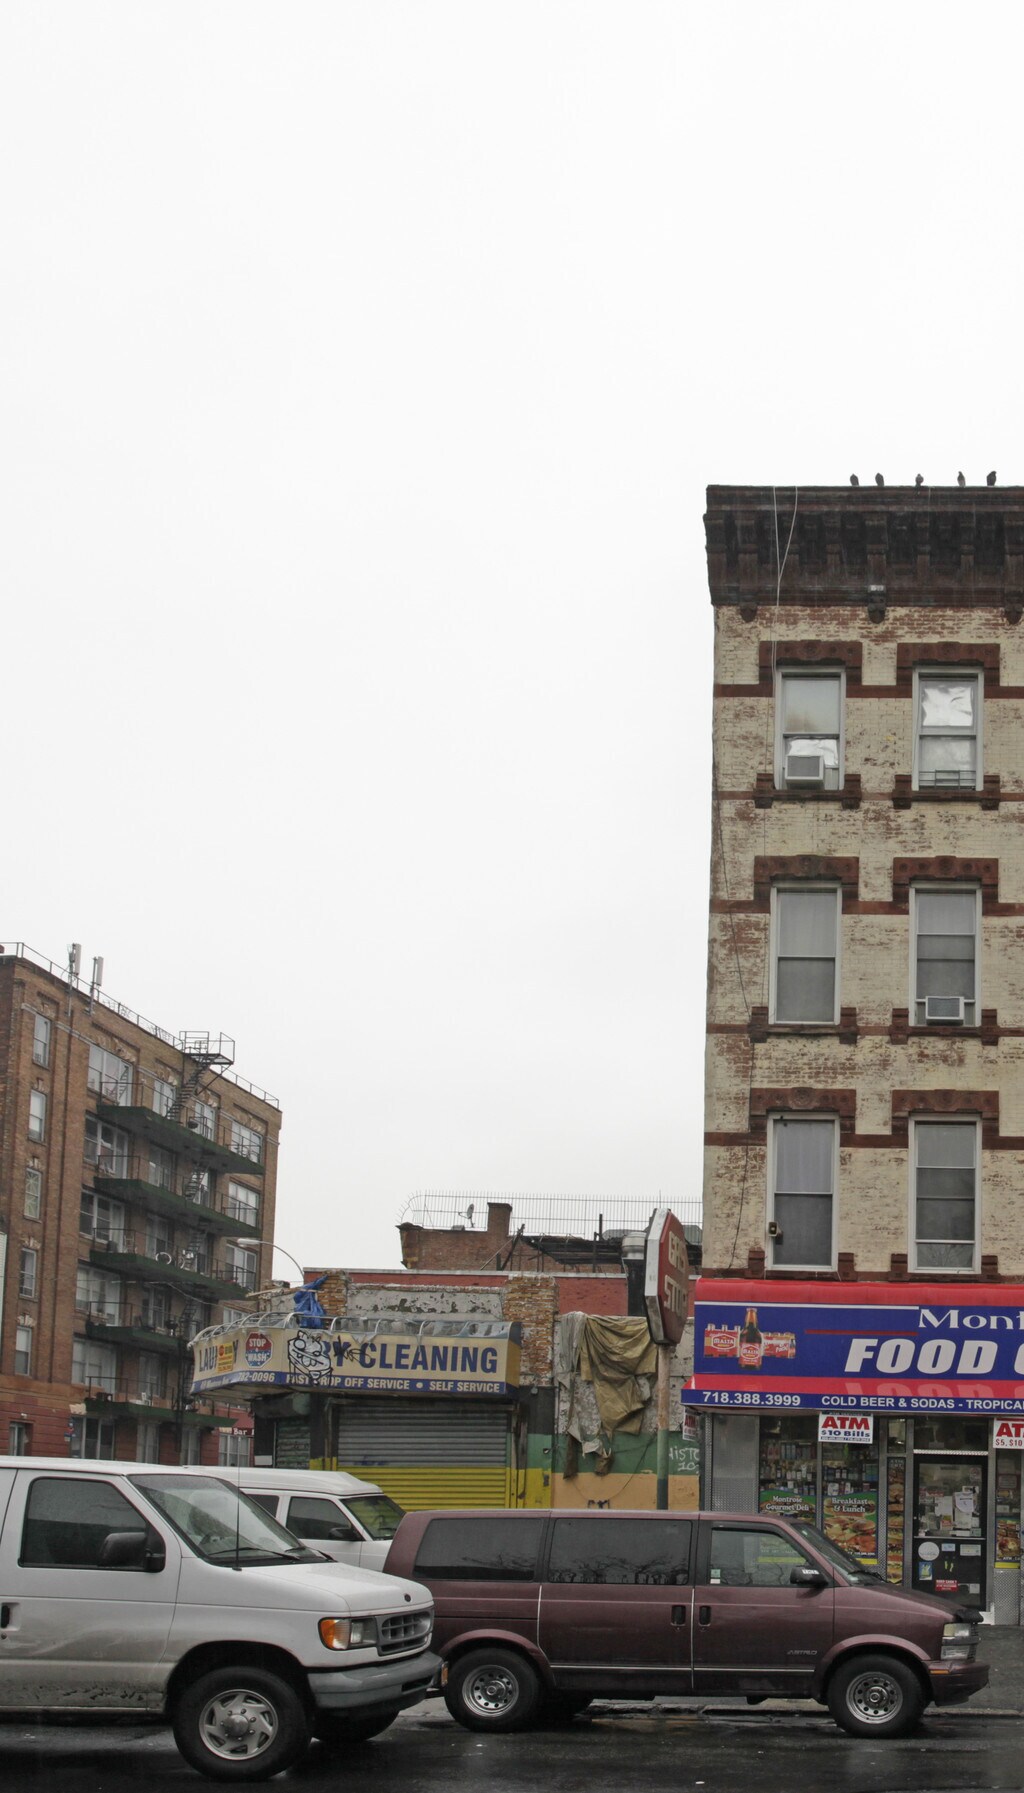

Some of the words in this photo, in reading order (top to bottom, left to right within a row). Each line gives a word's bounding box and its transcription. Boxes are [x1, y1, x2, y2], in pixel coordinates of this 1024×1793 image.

[249, 1338, 266, 1348] STOP
[360, 1341, 498, 1374] CLEANING
[844, 1338, 998, 1375] FOOD
[345, 1377, 364, 1387] OFF
[367, 1379, 410, 1389] SERVICE
[429, 1381, 453, 1391] SELF
[457, 1382, 500, 1393] SERVICE
[703, 1391, 801, 1406] 718.388.3999
[821, 1395, 856, 1406] COLD
[860, 1396, 895, 1407] BEER
[899, 1397, 907, 1407] &
[910, 1398, 955, 1409] SODAS
[821, 1416, 870, 1430] ATM
[233, 1427, 247, 1435] Bar
[1009, 1439, 1023, 1447] $10
[772, 1495, 802, 1503] Montrose
[832, 1497, 868, 1505] Breakfast
[766, 1503, 795, 1511] Gourmet
[796, 1503, 809, 1511] Deli
[842, 1505, 866, 1513] Lunch
